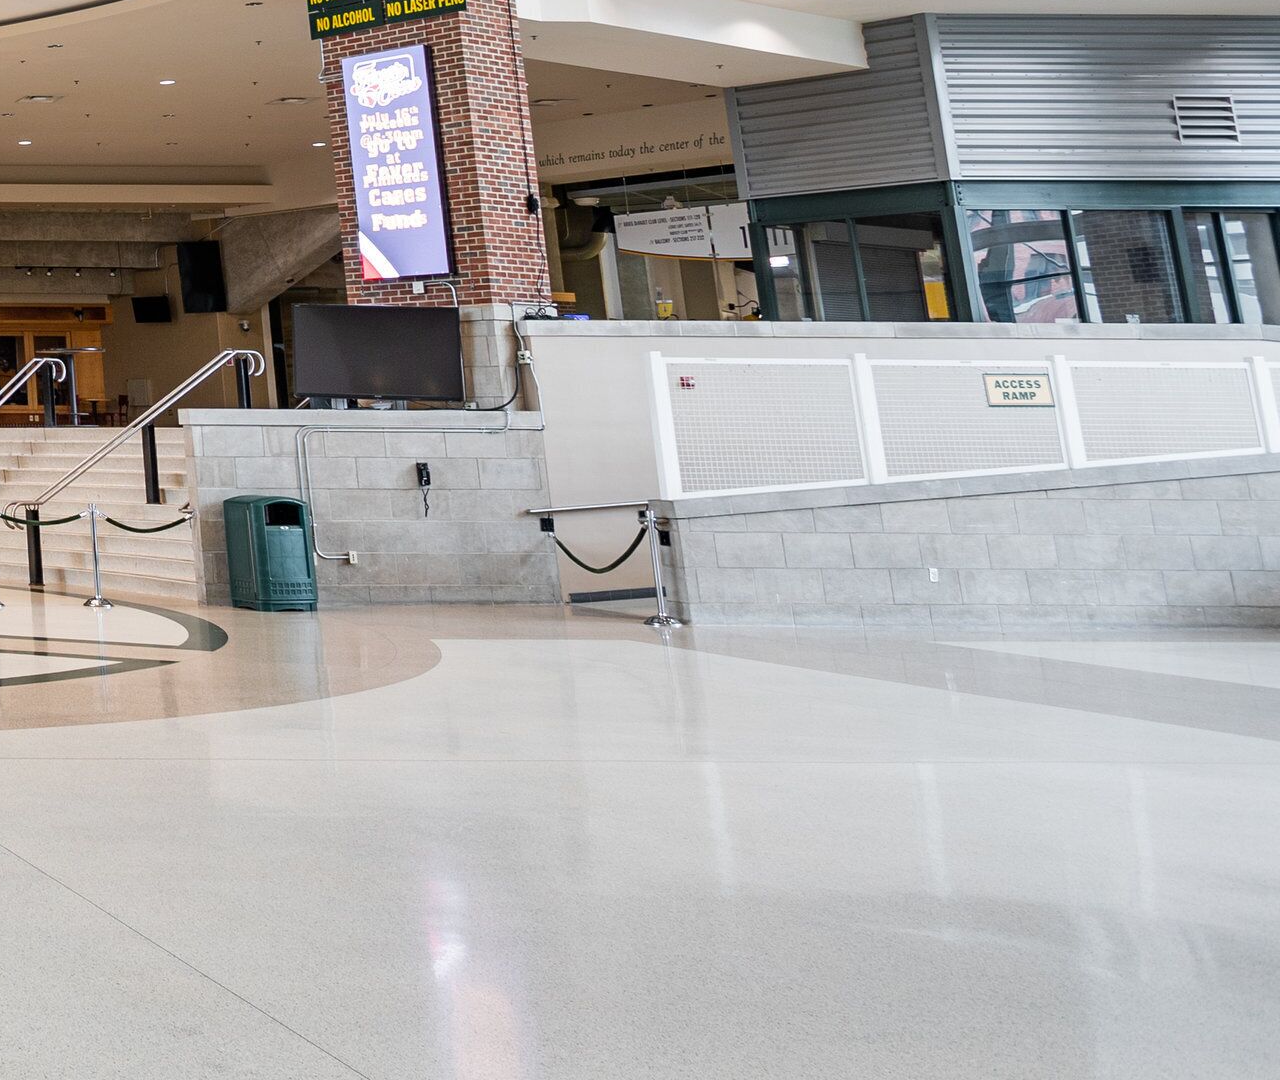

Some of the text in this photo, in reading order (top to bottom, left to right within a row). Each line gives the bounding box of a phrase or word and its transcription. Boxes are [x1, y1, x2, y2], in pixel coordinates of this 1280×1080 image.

[386, 2, 402, 17] NO
[316, 7, 375, 32] NO ALCOHOL
[539, 132, 725, 167] which remains today the center of the
[994, 380, 1041, 389] ACCESS
[1002, 391, 1037, 400] RAMP
